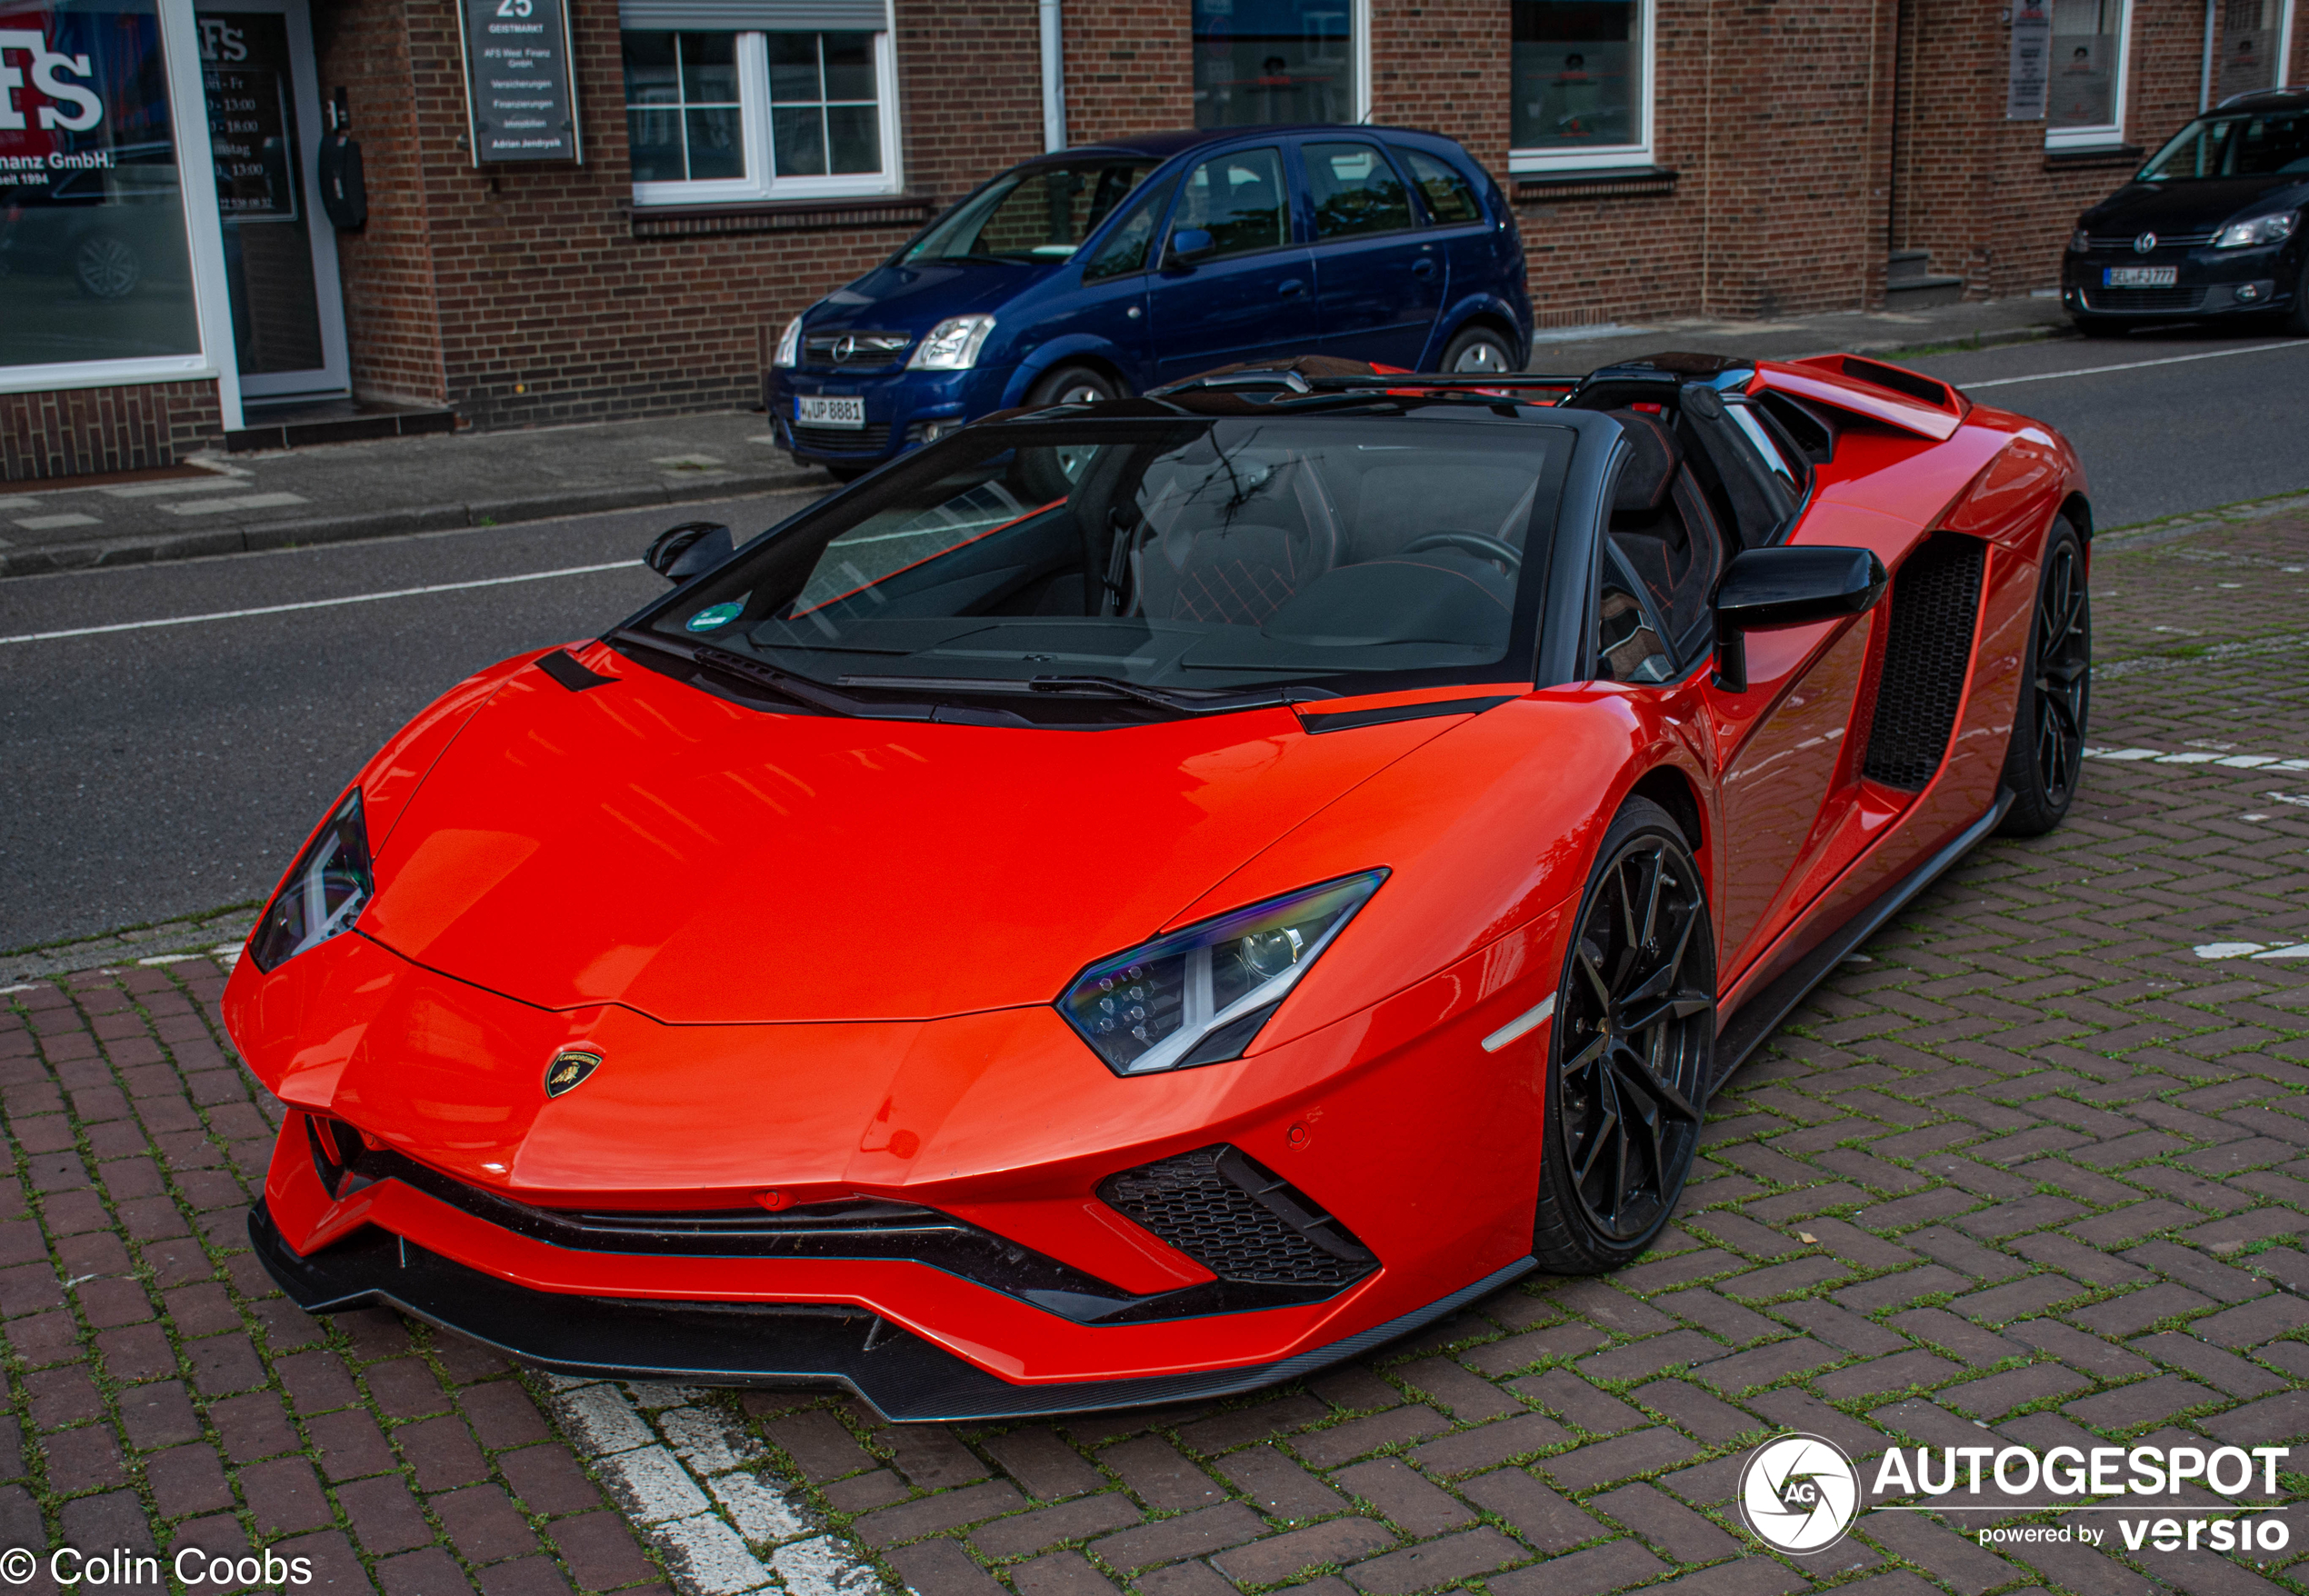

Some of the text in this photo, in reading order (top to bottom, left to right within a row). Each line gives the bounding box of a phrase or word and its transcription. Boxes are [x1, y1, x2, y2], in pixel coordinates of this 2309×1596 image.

[496, 0, 534, 17] 25
[488, 24, 544, 34] GEISTMARKT
[485, 48, 502, 58] AFS
[525, 47, 551, 58] Finanz
[491, 79, 553, 90] Versicherungen
[493, 98, 554, 110] Finanzierungen
[504, 119, 547, 129] Immobilien
[492, 139, 521, 149] Adrian
[48, 151, 115, 169] GmbH.
[829, 401, 861, 420] 8881
